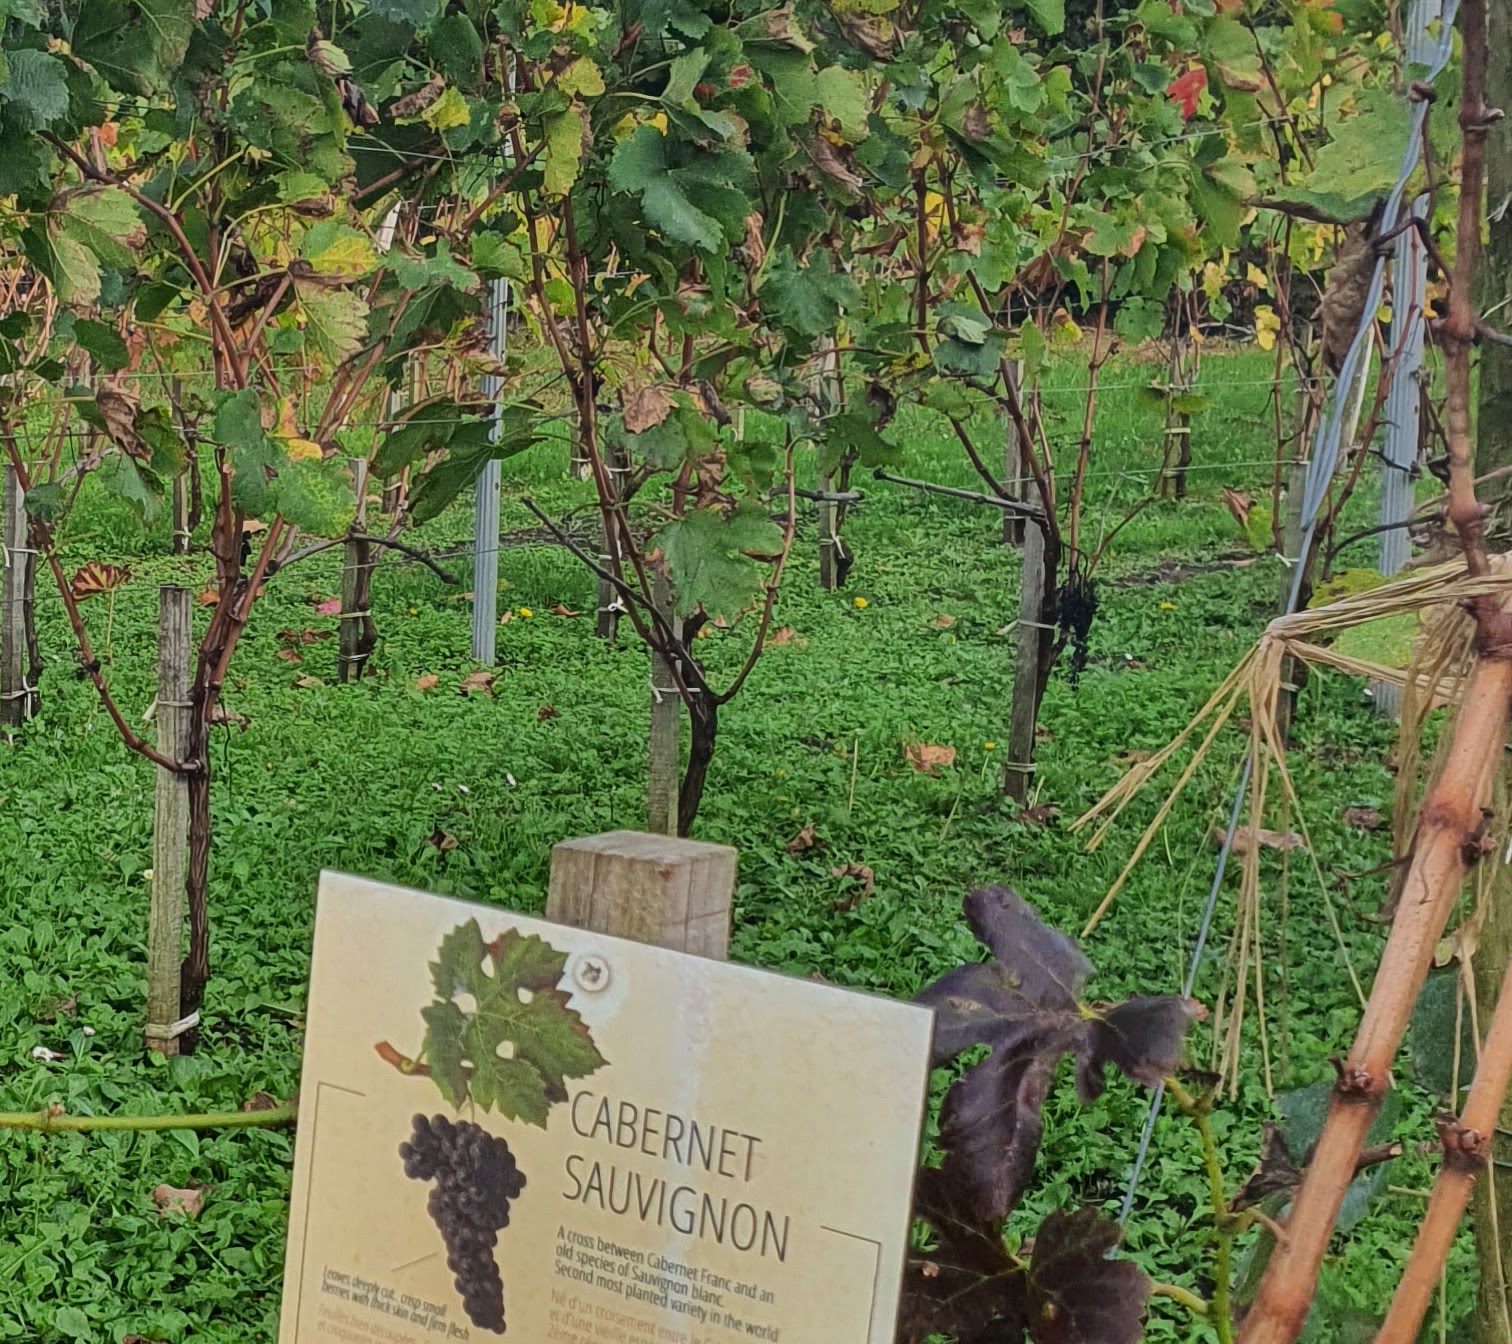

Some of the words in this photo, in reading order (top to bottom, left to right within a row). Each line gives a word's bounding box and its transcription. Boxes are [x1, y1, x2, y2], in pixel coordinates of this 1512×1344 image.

[570, 1089, 762, 1183] CABERNET
[561, 1153, 790, 1262] SAUVIGNON
[554, 1258, 593, 1285] Second
[595, 1274, 623, 1295] most
[624, 1282, 668, 1309] planted
[669, 1297, 708, 1325] variety
[709, 1311, 721, 1325] in
[723, 1312, 743, 1332] the
[555, 1242, 573, 1261] old
[575, 1250, 616, 1274] species
[616, 1261, 630, 1278] of
[630, 1264, 689, 1296] Sauvignon
[556, 1224, 565, 1240] A
[566, 1229, 594, 1250] cross
[596, 1235, 644, 1265] between
[646, 1251, 699, 1282] Cabernet
[699, 1267, 731, 1291] Franc
[733, 1281, 757, 1299] and
[758, 1288, 774, 1304] an
